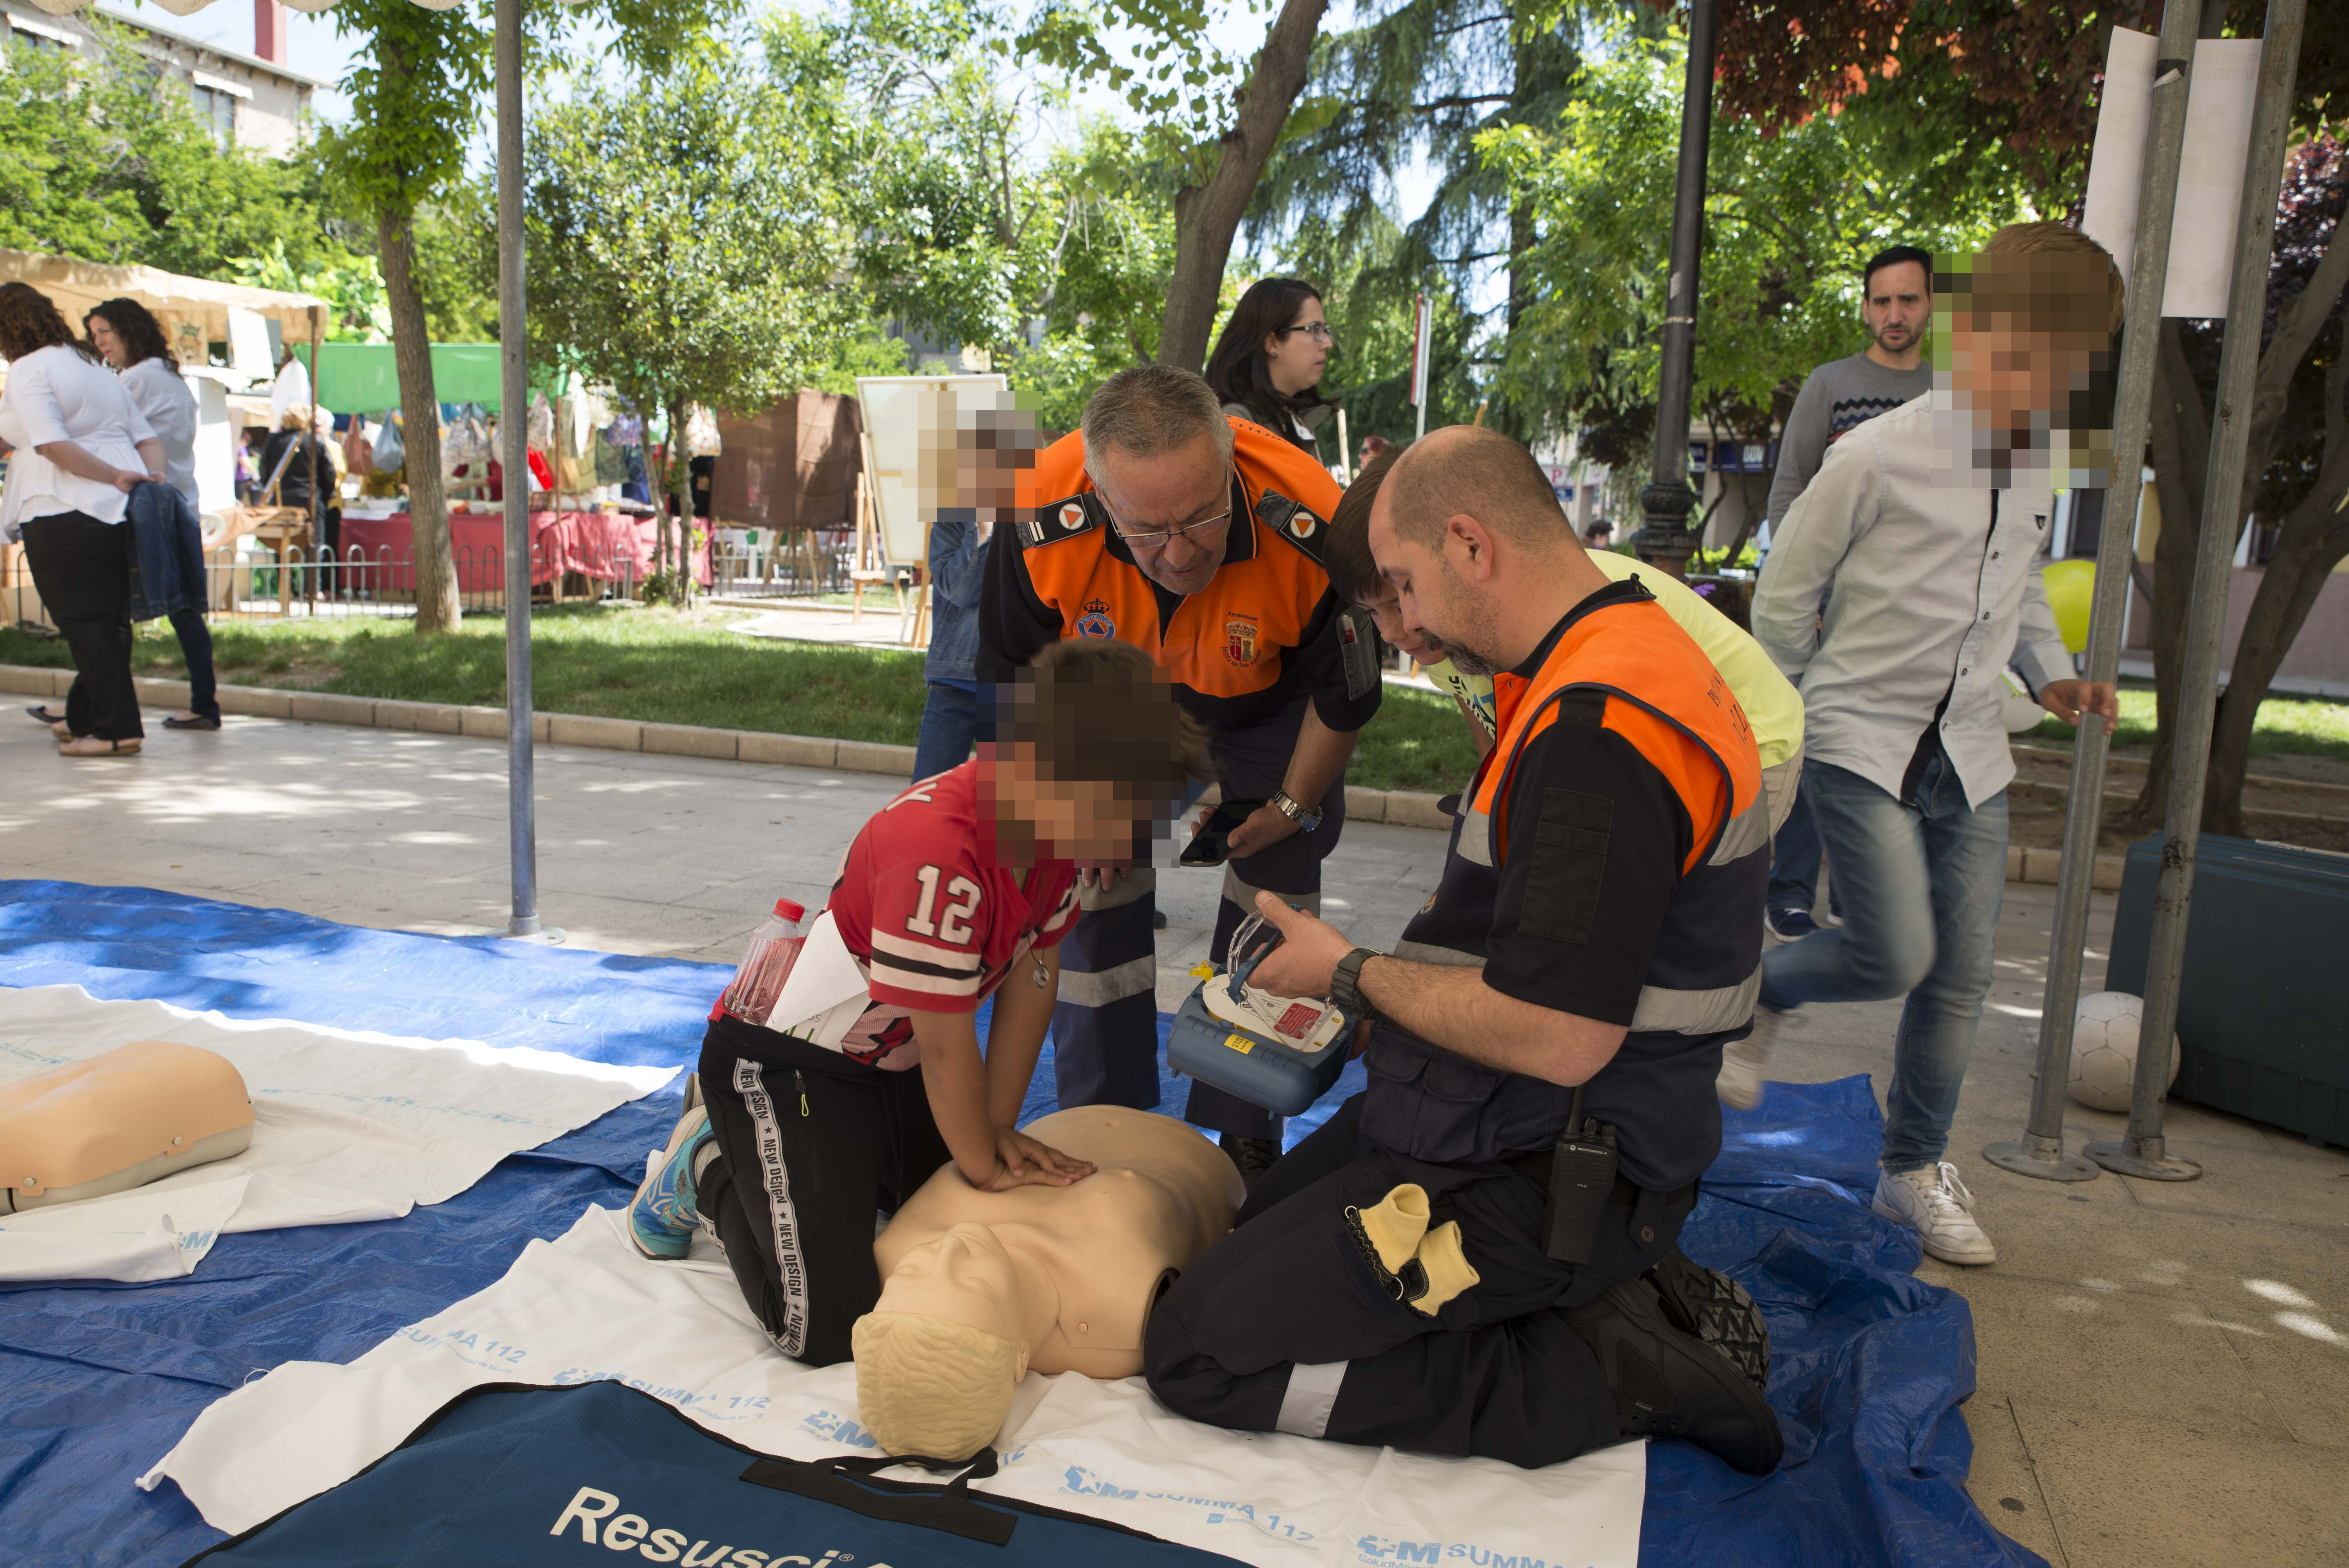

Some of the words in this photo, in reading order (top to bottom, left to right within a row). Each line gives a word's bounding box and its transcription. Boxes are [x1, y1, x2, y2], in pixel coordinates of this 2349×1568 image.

[1228, 611, 1258, 621] Ayuntamiento
[906, 863, 983, 946] 12
[740, 1069, 755, 1089] NEW
[763, 1139, 779, 1164] NEW
[770, 1167, 788, 1204] DESIGN
[779, 1223, 795, 1251] NEW
[783, 1254, 802, 1297] DESIGN
[789, 1313, 803, 1343] NEW
[485, 1341, 527, 1364] 112
[729, 1396, 772, 1409] 112
[1267, 1515, 1315, 1541] 112
[1447, 1543, 1563, 1568] SUMM
